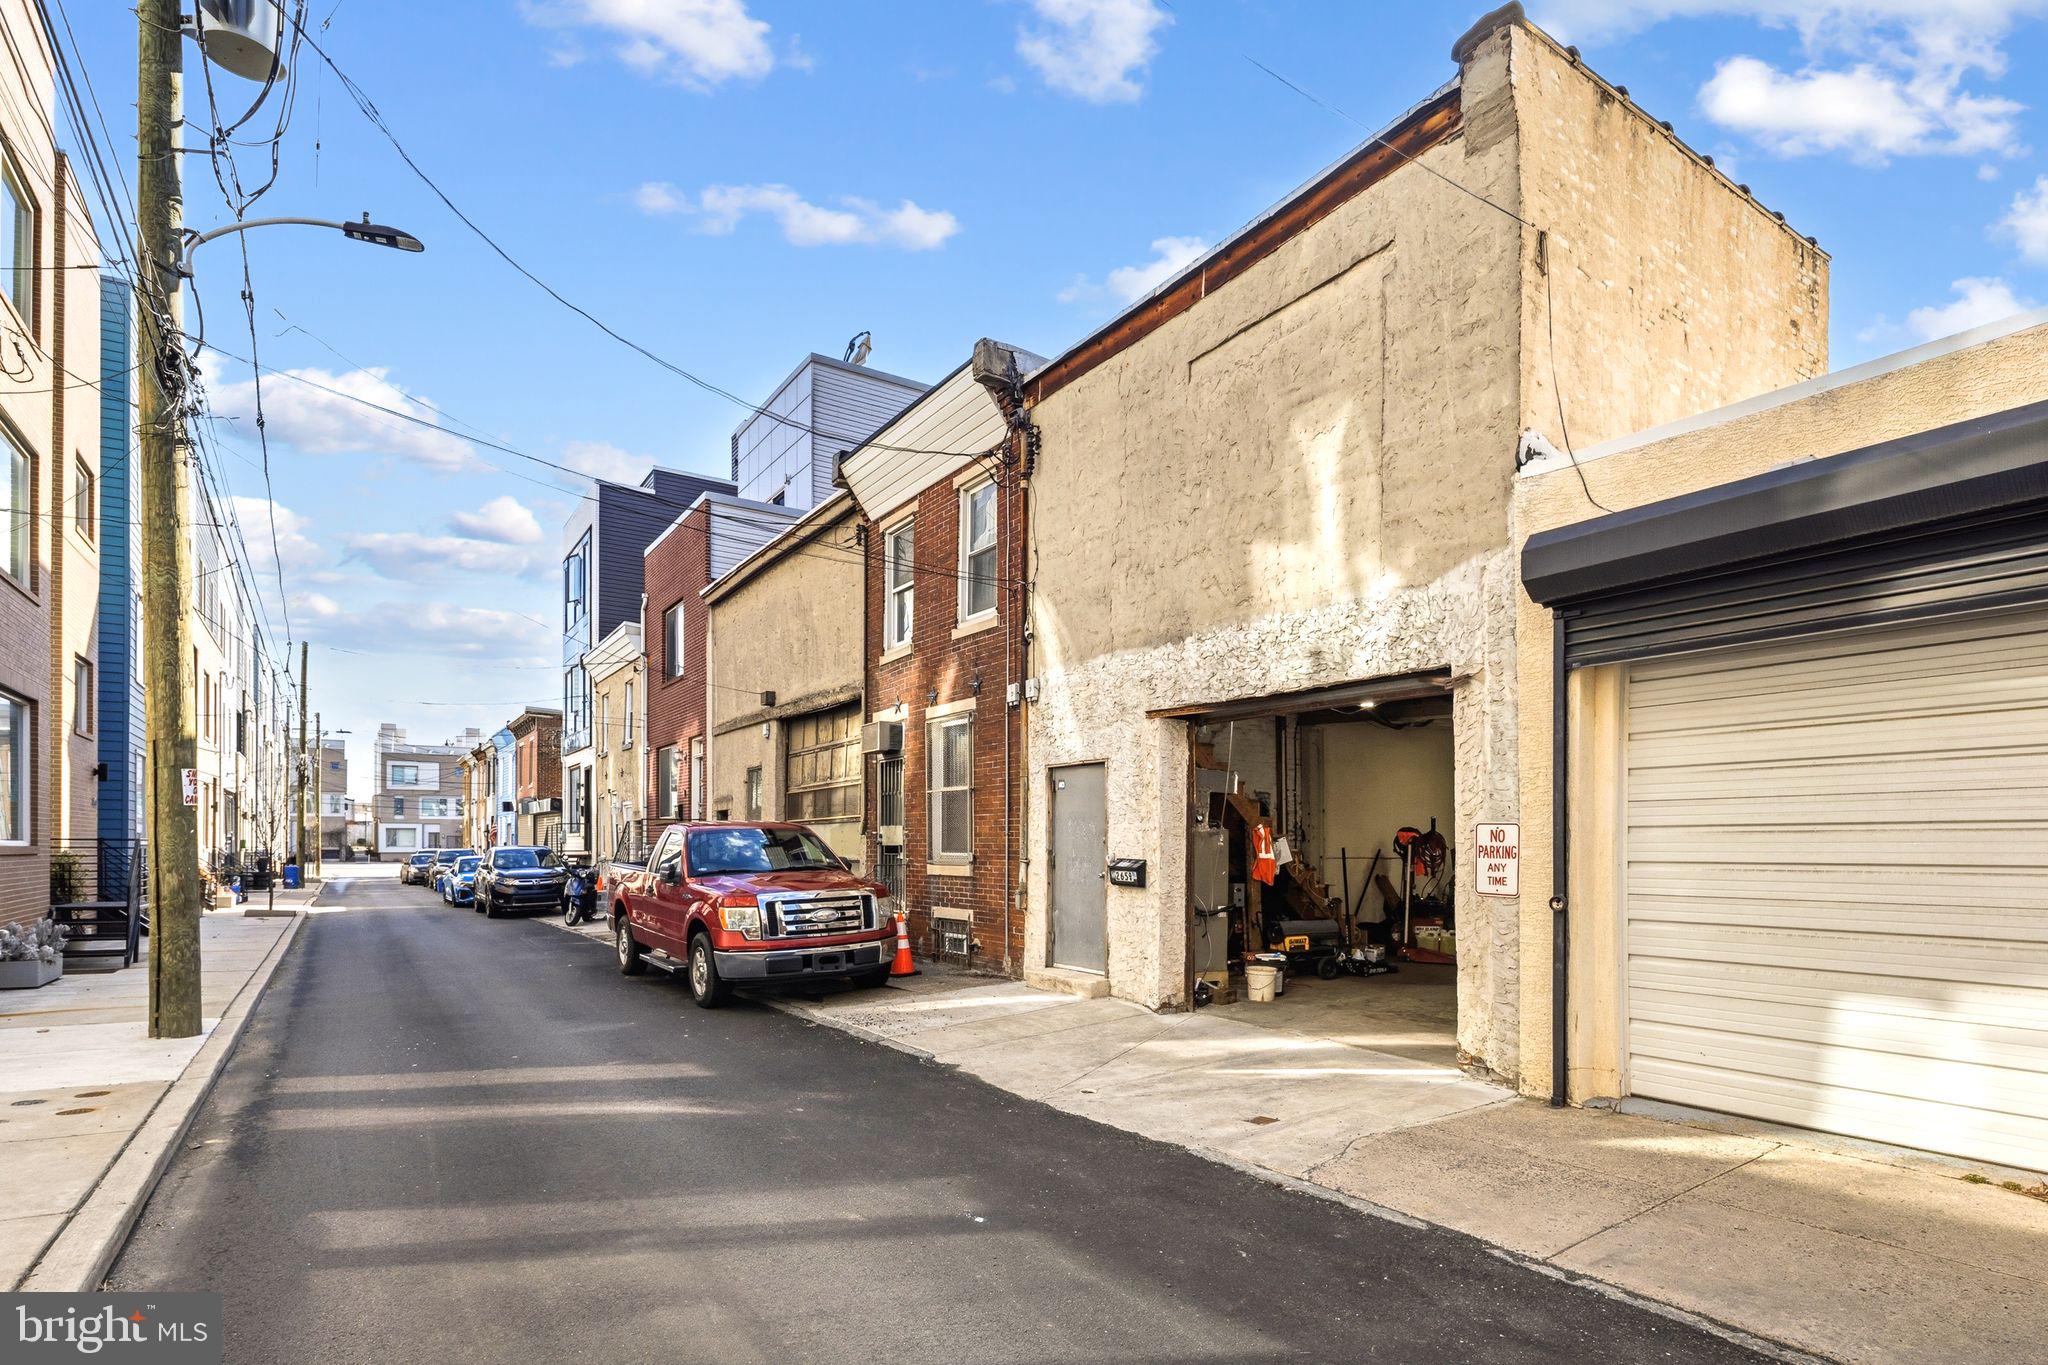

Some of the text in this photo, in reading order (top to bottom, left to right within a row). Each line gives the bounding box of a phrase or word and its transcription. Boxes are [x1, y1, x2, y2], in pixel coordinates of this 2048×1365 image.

[1490, 829, 1505, 843] NO
[1478, 845, 1517, 859] PARKING
[1487, 863, 1507, 873] ANY
[1487, 876, 1507, 886] TIME
